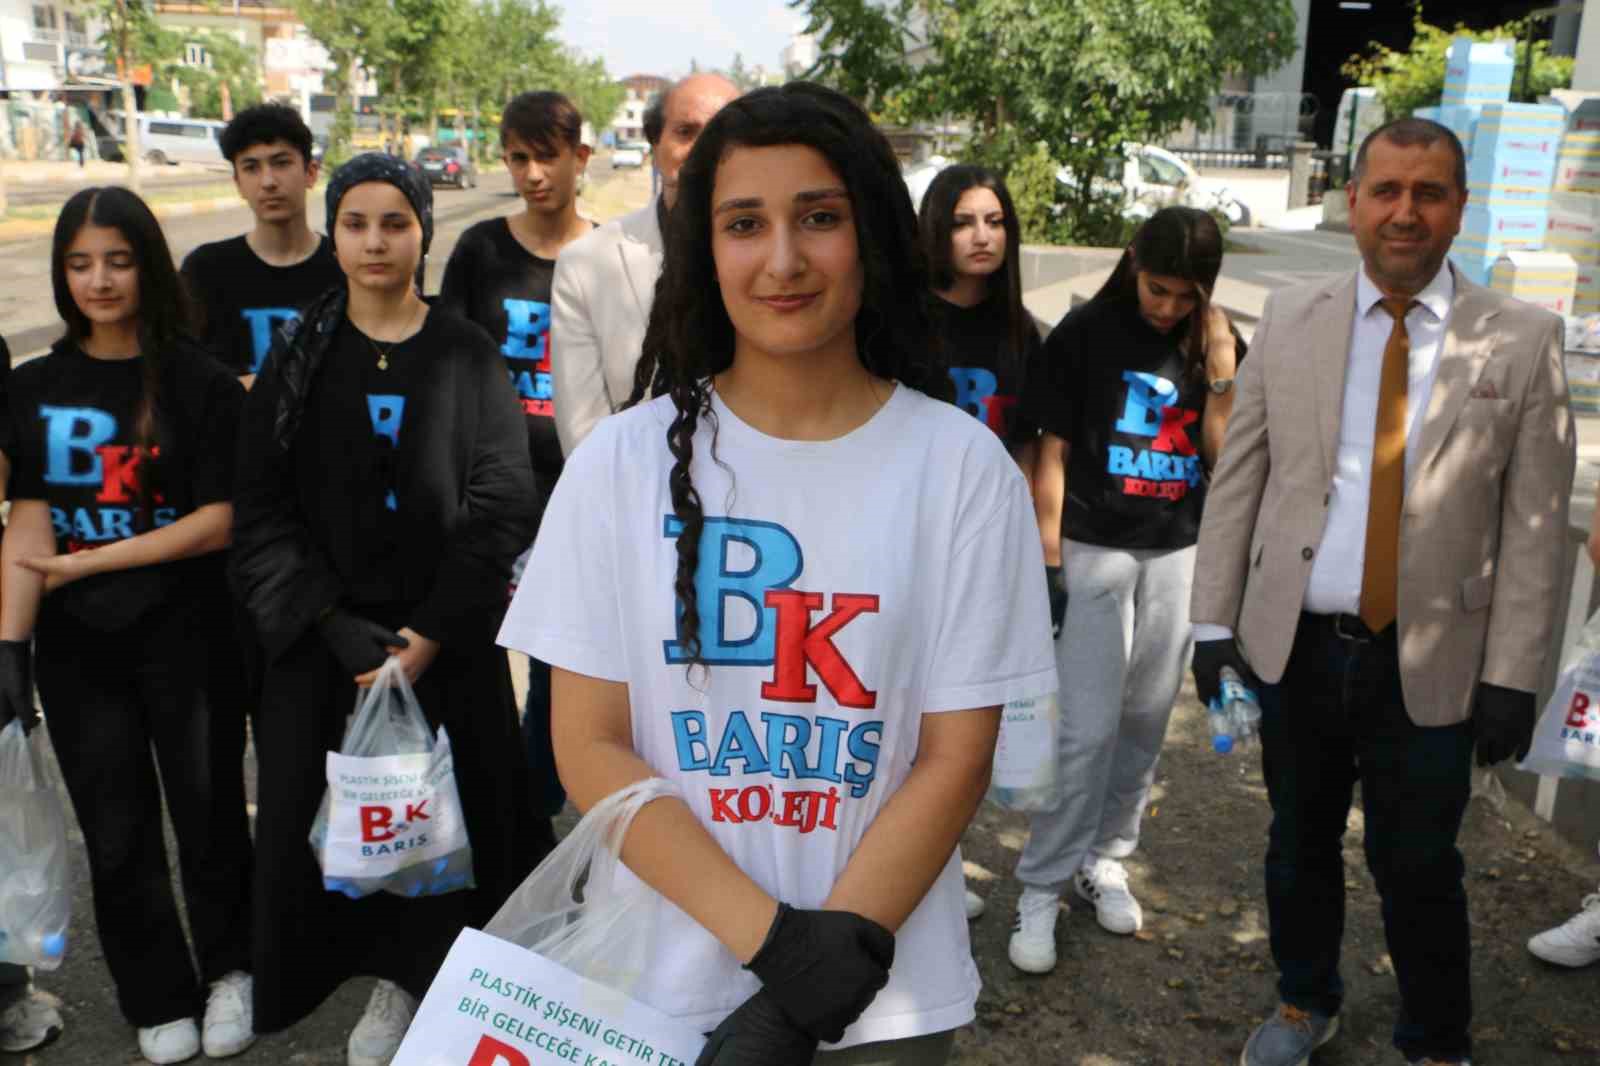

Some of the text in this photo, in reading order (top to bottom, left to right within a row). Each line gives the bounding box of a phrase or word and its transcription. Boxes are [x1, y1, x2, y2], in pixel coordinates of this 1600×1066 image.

[1116, 370, 1198, 455] BK
[663, 514, 880, 709] BK
[671, 710, 884, 798] BARIŞ
[708, 784, 840, 833] KOEJİ
[457, 995, 490, 1021] BİR
[492, 1012, 583, 1063] GELECEĞE
[469, 967, 543, 1010] PLASTİK
[543, 997, 602, 1038] ŞİŞENİ
[602, 1028, 654, 1062] GETİR
